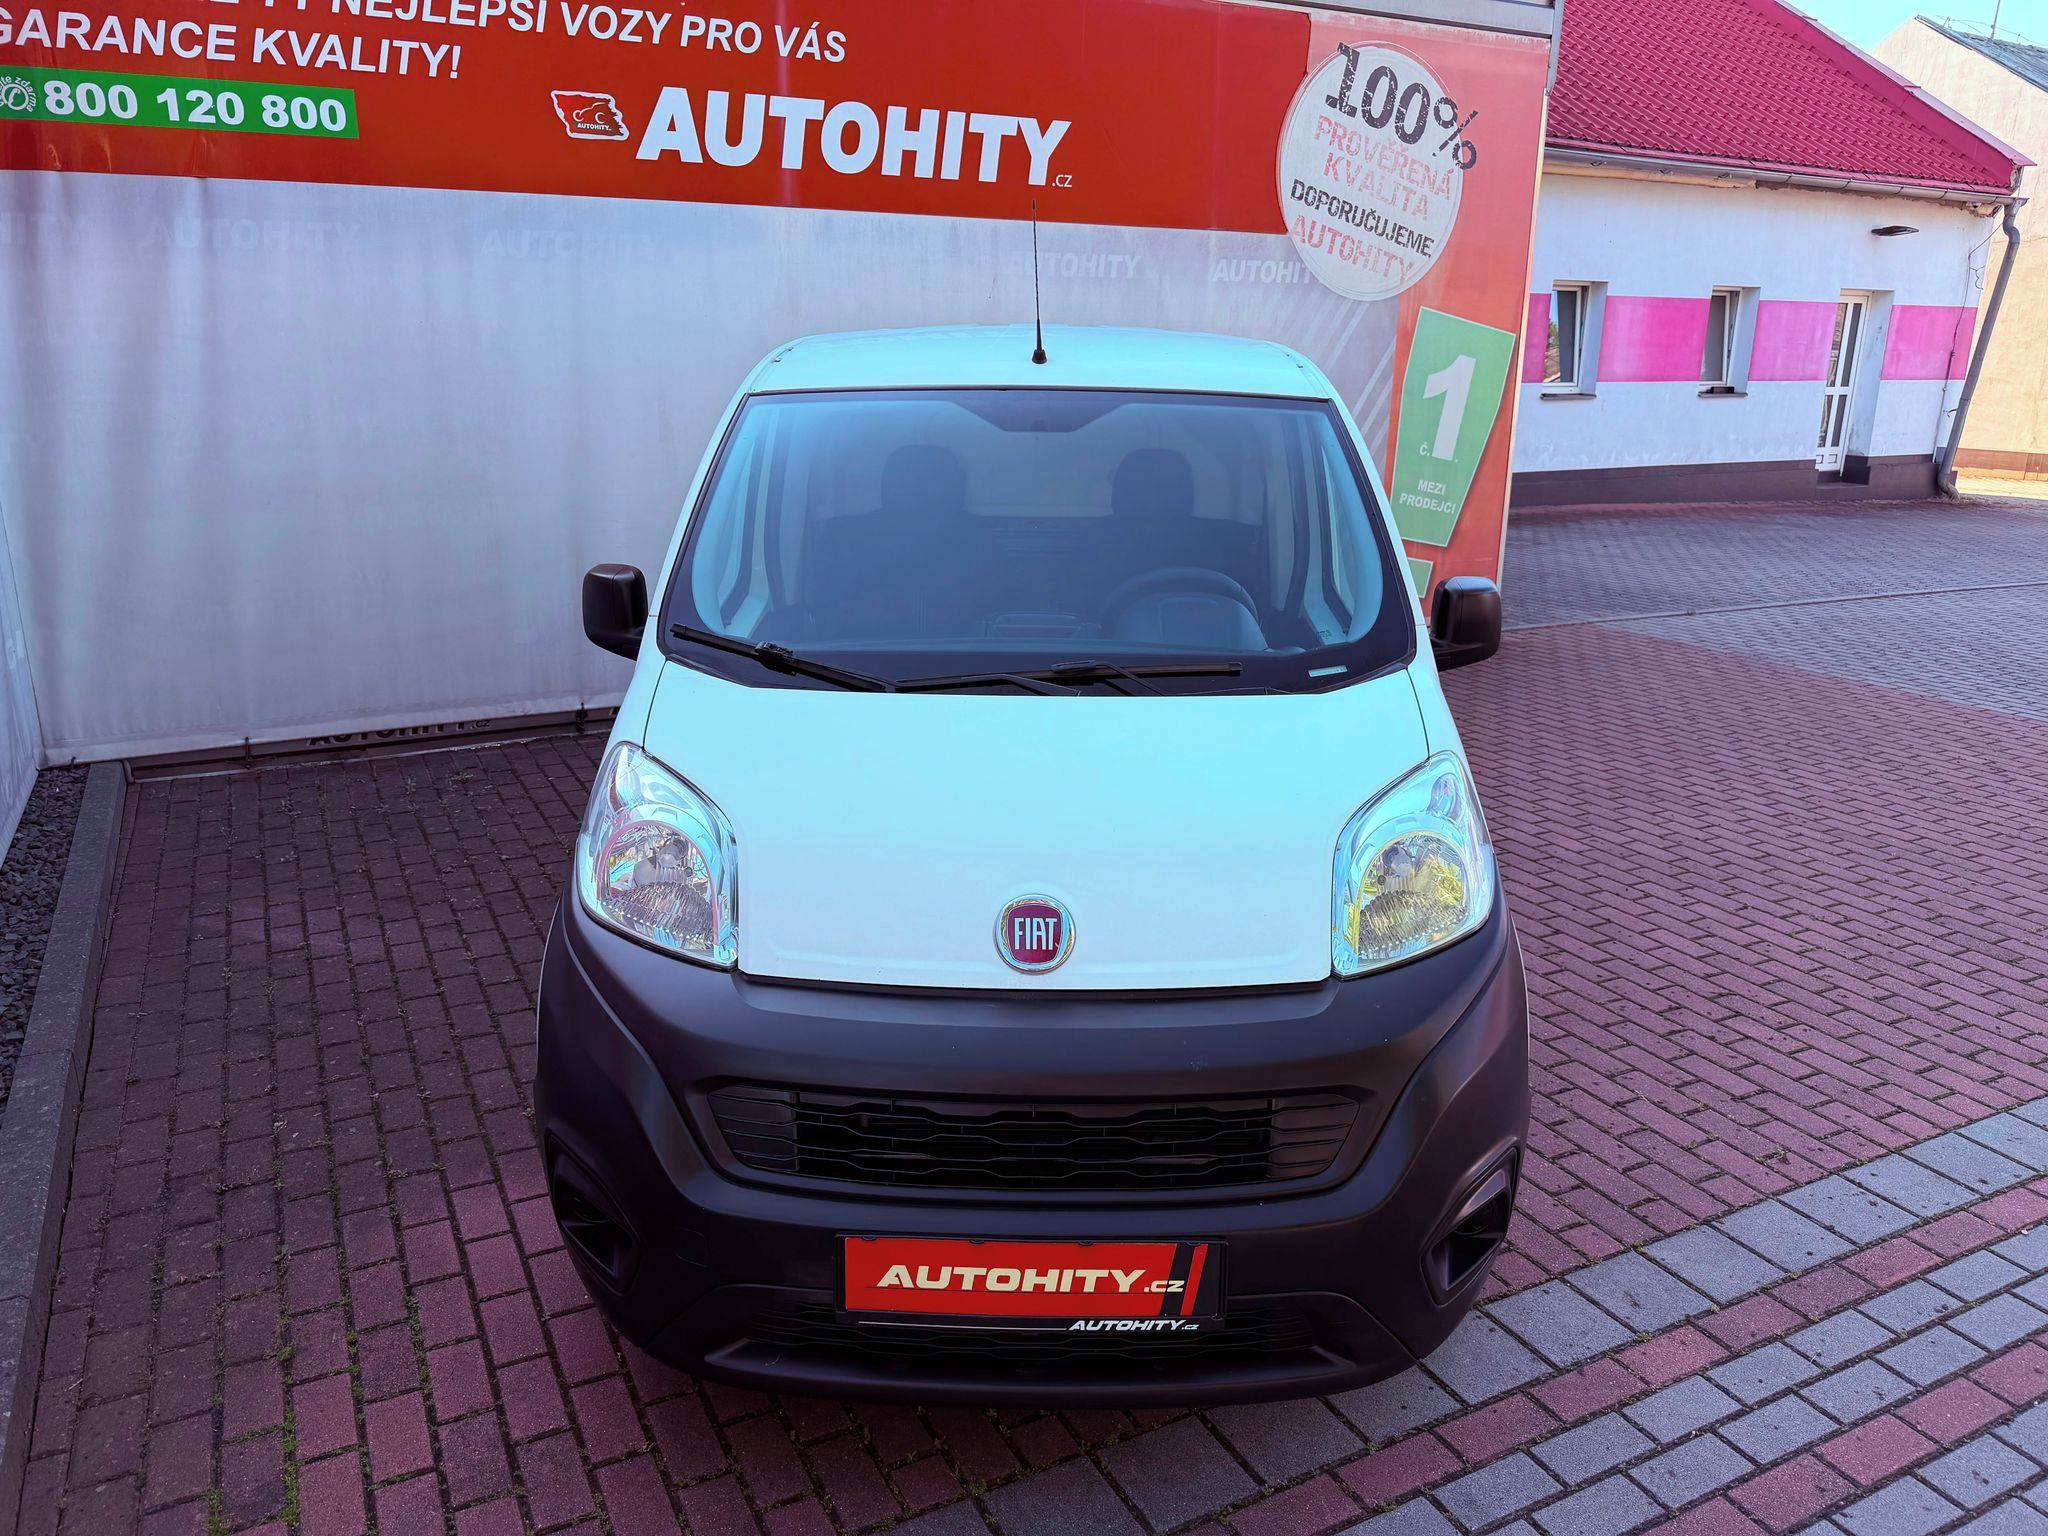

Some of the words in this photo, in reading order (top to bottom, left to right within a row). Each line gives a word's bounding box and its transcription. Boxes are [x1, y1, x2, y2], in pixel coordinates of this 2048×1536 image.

[253, 27, 462, 79] KVALITY!
[560, 1, 672, 45] VOZY
[680, 15, 762, 53] PRO
[774, 21, 847, 63] VÁS
[43, 80, 138, 119] 800
[156, 87, 245, 125] 120
[261, 94, 347, 132] 800
[1325, 42, 1479, 170] 100%
[1323, 152, 1429, 222] KVALITA
[1290, 178, 1435, 259] DOPORUČUJEME
[1291, 214, 1415, 282] AUTOHITY
[1399, 493, 1456, 514] PRODEJCI
[1417, 479, 1447, 496] MEZI
[1014, 917, 1058, 951] FIAT
